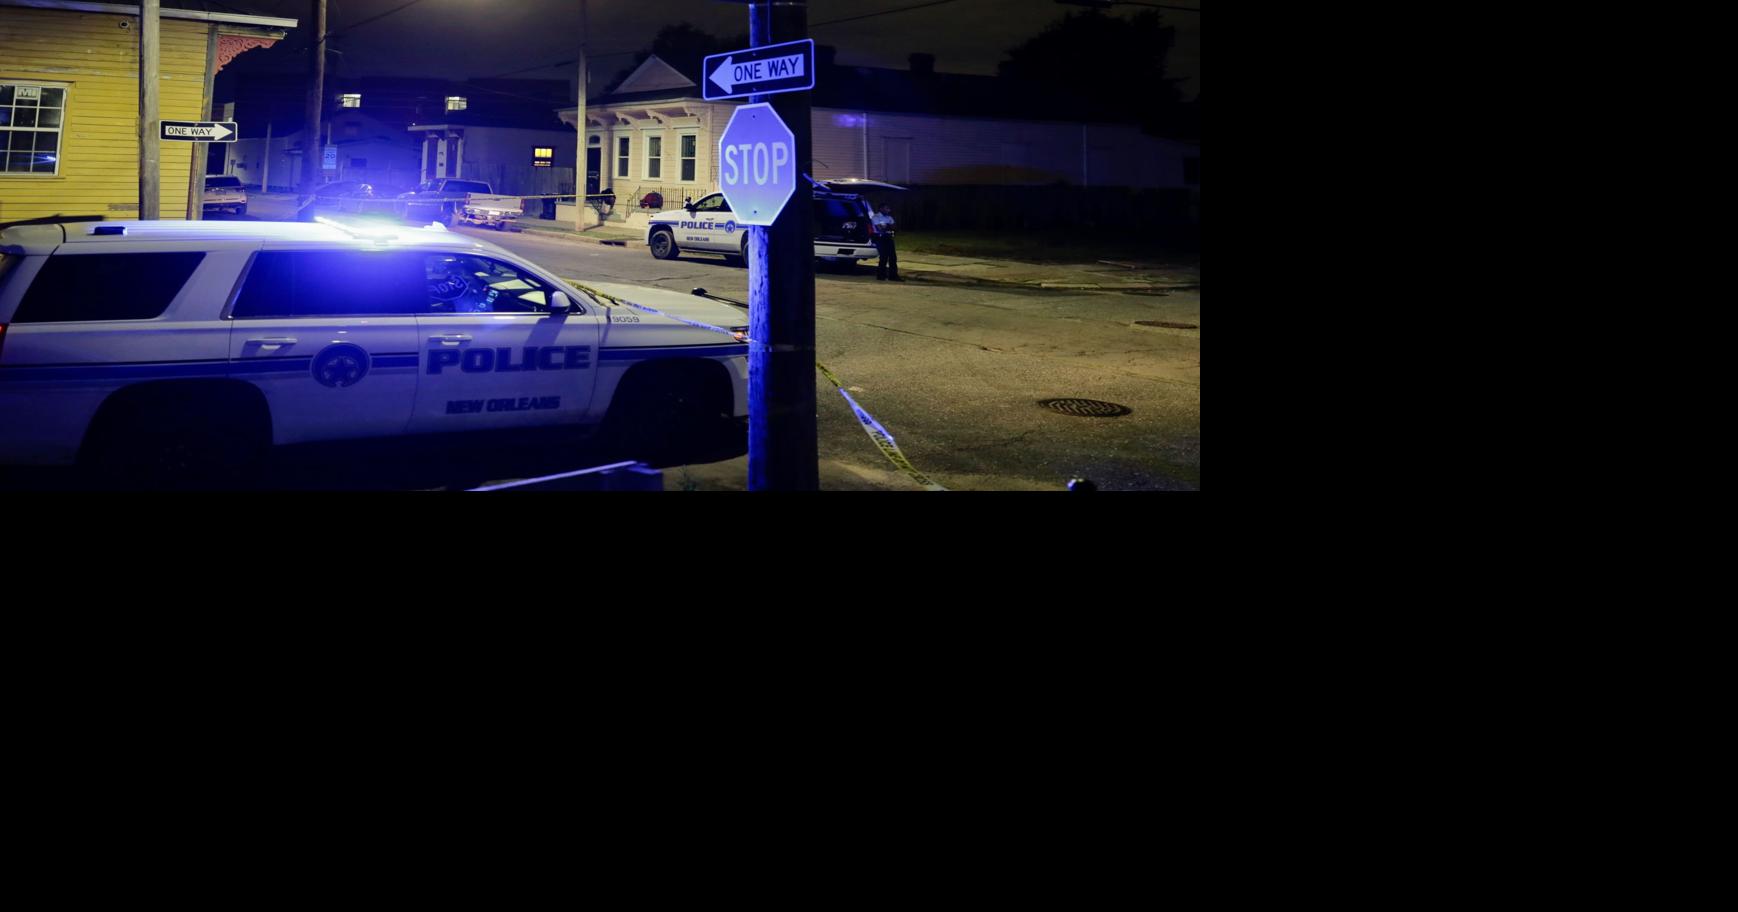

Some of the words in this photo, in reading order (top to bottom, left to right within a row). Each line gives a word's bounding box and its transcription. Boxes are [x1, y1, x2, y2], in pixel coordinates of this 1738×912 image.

[734, 63, 762, 82] ONE
[767, 57, 799, 78] WAY
[168, 127, 187, 135] ONE
[725, 142, 788, 185] STOP
[681, 221, 713, 230] POLICE
[426, 345, 591, 375] POLICE
[446, 400, 484, 414] NEW
[486, 396, 561, 412] ORLEANS
